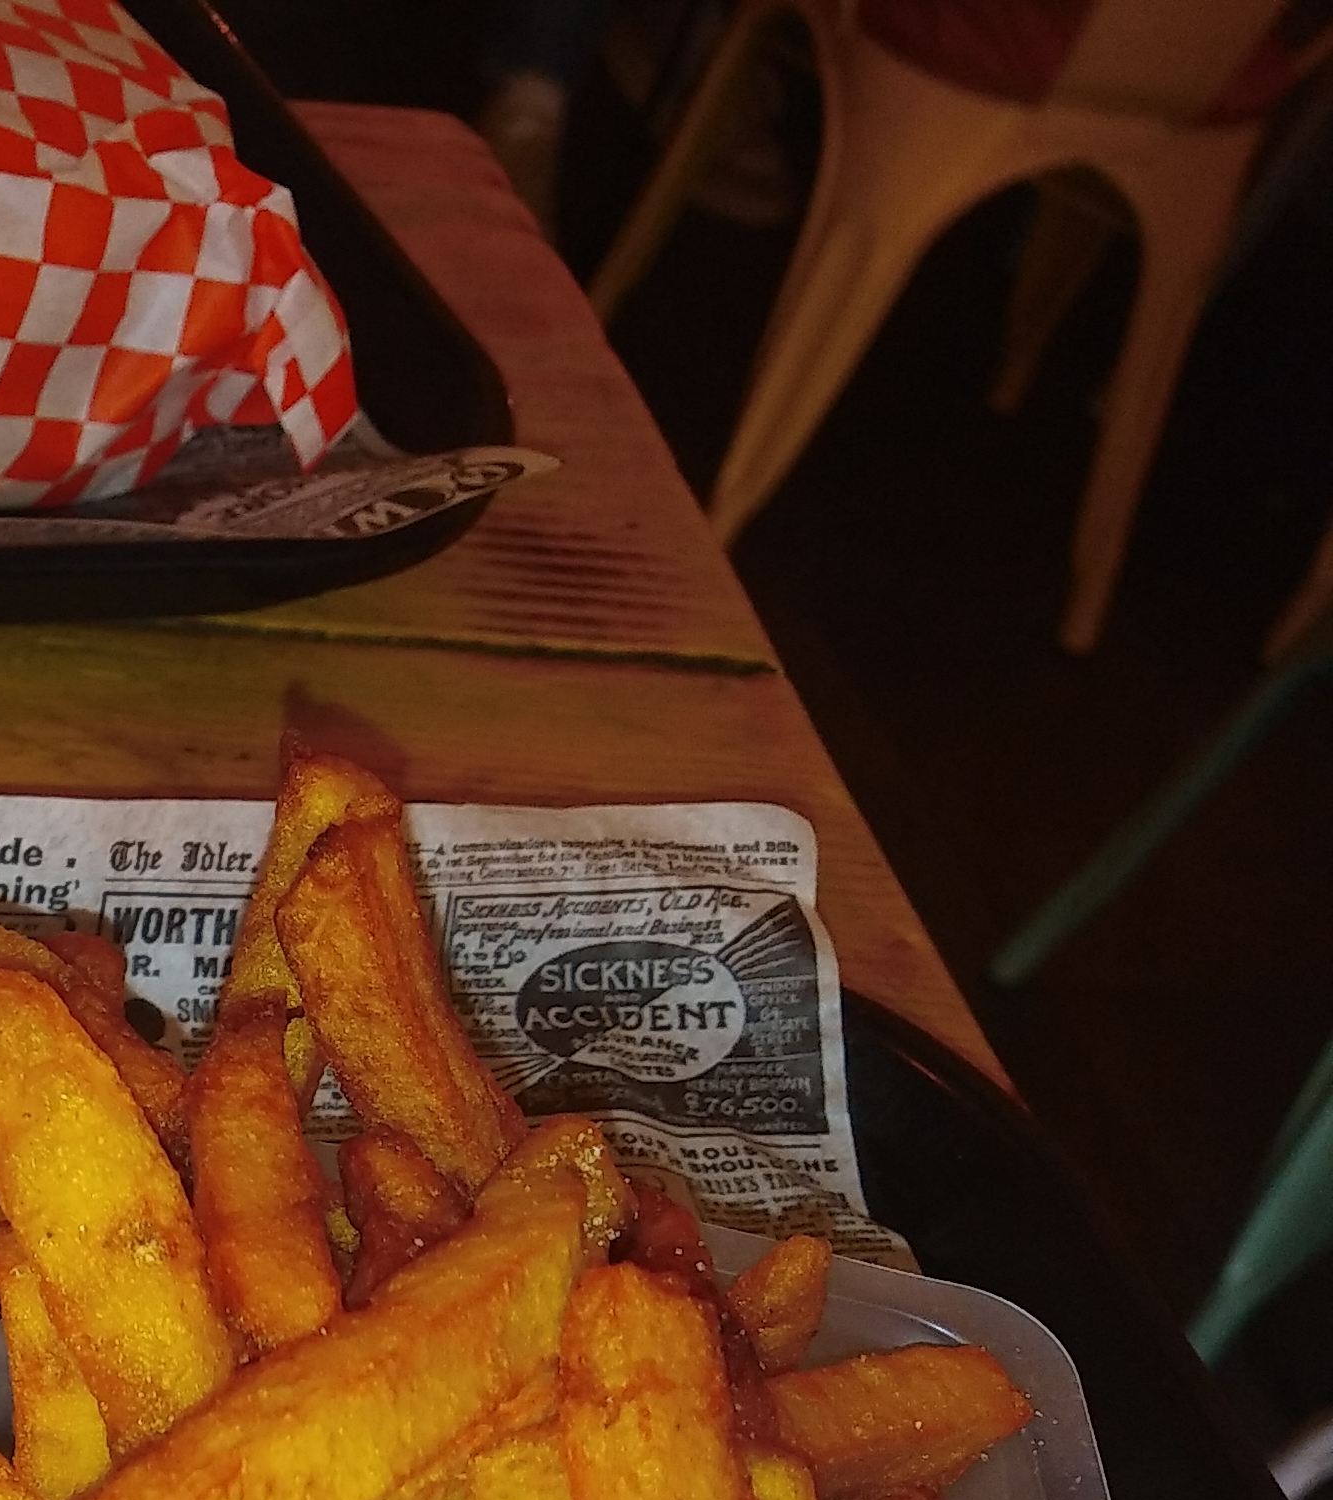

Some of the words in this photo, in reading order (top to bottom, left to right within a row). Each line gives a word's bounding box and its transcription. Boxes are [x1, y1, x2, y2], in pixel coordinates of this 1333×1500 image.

[109, 840, 163, 875] The
[181, 840, 259, 875] Idler.
[660, 892, 702, 912] OLD
[112, 906, 238, 946] WORTH
[540, 955, 714, 994] SICKNESS
[524, 1001, 737, 1032] ACCIDENT
